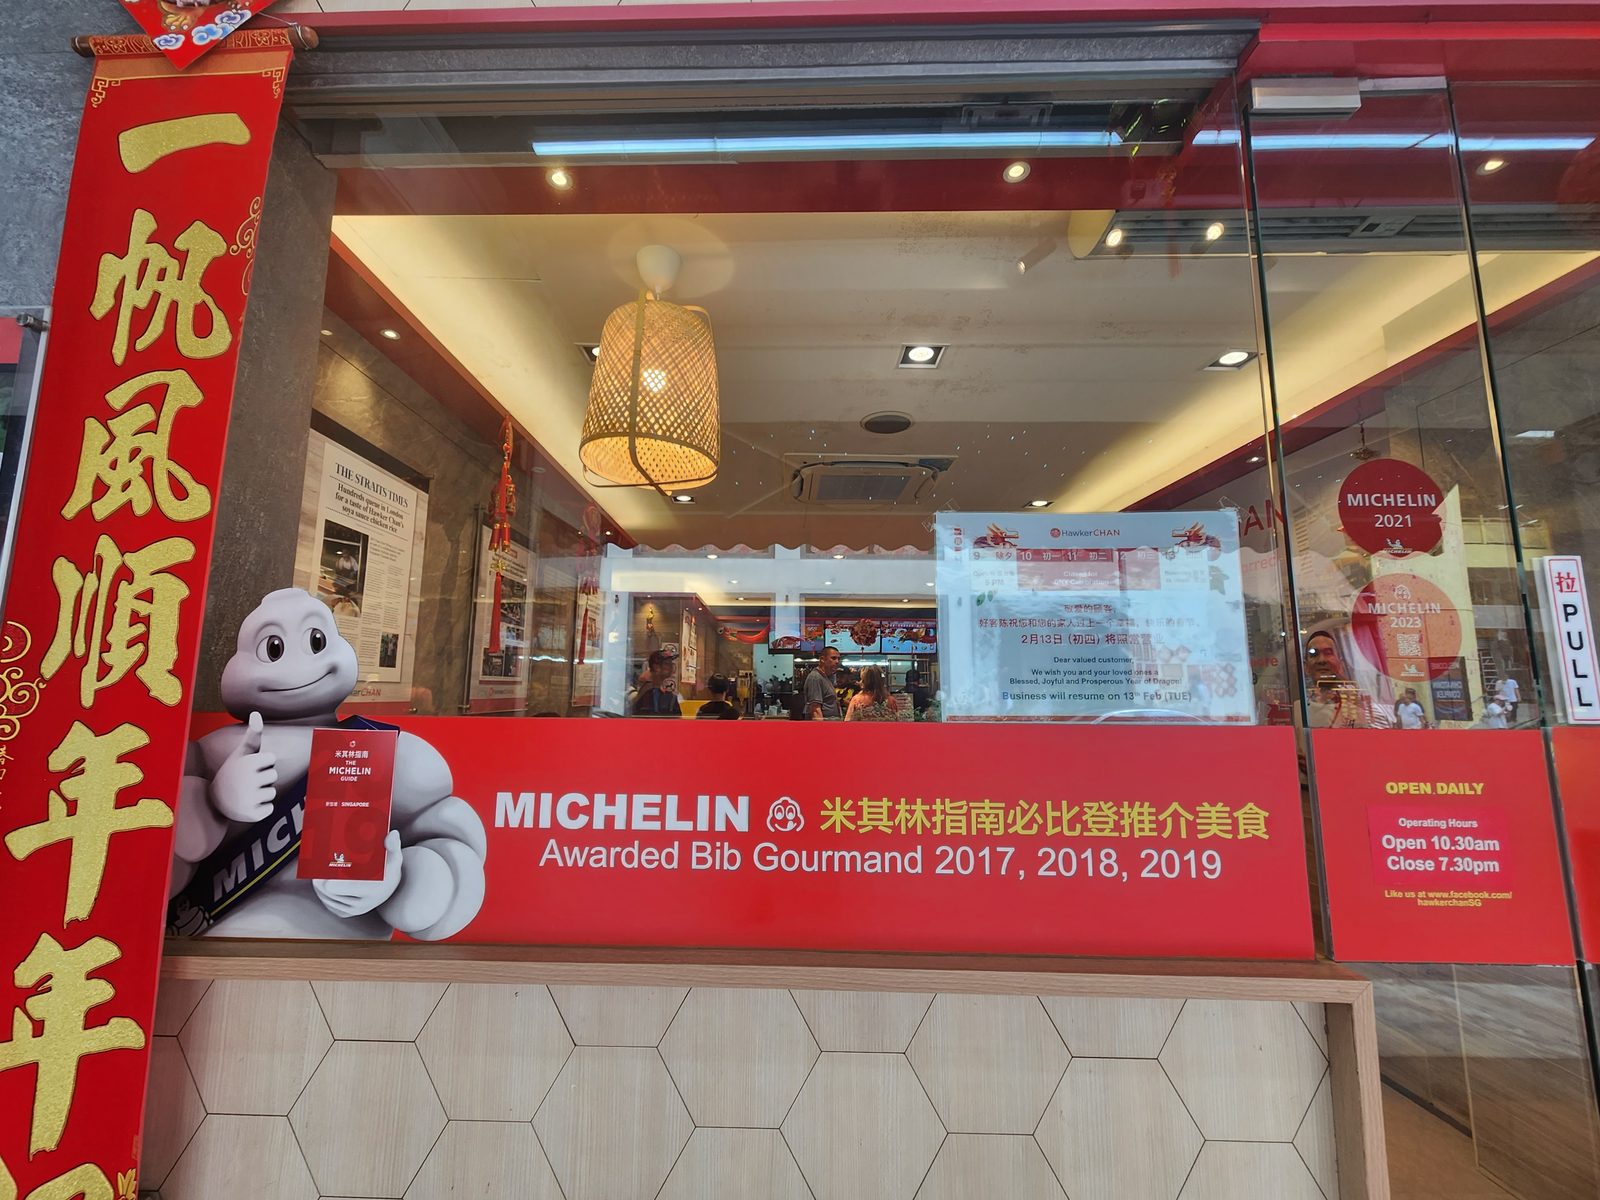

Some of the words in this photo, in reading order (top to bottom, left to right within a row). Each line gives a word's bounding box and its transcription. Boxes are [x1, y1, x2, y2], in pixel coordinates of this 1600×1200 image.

[335, 462, 354, 481] THE
[355, 473, 387, 498] STRAITS
[387, 488, 408, 508] TIMES
[337, 483, 365, 501] Hundreds
[365, 497, 380, 509] queue
[386, 504, 404, 520] London
[1346, 493, 1436, 507] MICHELIN
[335, 492, 344, 502] for
[349, 498, 362, 510] taste
[362, 503, 368, 512] of
[368, 505, 388, 521] Hawker
[388, 514, 404, 528] Chan's
[342, 505, 355, 516] soya
[355, 510, 370, 522] sauce
[370, 515, 389, 530] chicken
[389, 522, 398, 533] rice
[1374, 514, 1412, 528] 2021
[1062, 528, 1120, 537] HawkerCHAN
[1021, 551, 1032, 561] 10
[1067, 551, 1078, 561] 11
[1554, 572, 1579, 593] 拉
[1367, 602, 1441, 614] MICHELIN
[1390, 616, 1421, 628] 2023
[0, 113, 250, 1200] 一帆風順年年
[1098, 657, 1134, 665] customer,
[1563, 603, 1592, 707] PULL
[1041, 678, 1064, 686] Joyful
[1081, 678, 1123, 686] Prosperous
[1002, 692, 1047, 700] Business
[1049, 692, 1067, 700] will
[1143, 691, 1162, 701] Feb
[1165, 692, 1192, 702] (TUE)
[329, 766, 371, 775] MICHELIN
[1385, 781, 1431, 795] OPEN
[1436, 782, 1484, 795] DAILY
[494, 792, 749, 832] MICHELIN
[820, 797, 1270, 840] 米其林指南必比登推介美食
[1398, 817, 1447, 829] Operating
[1448, 818, 1478, 828] Hours
[1381, 834, 1427, 852] Open
[1431, 835, 1500, 851] 10.30am
[539, 838, 679, 869] Awarded
[691, 841, 741, 871] Bib
[753, 842, 923, 875] Gourmand
[935, 845, 1025, 880] 2017,
[1037, 847, 1129, 882] 2018,
[1140, 849, 1222, 879] 2019
[1386, 855, 1435, 871] Close
[1438, 857, 1500, 875] 7.30pm
[1384, 890, 1403, 898] Like
[1417, 898, 1482, 907] hawkerchanSG
